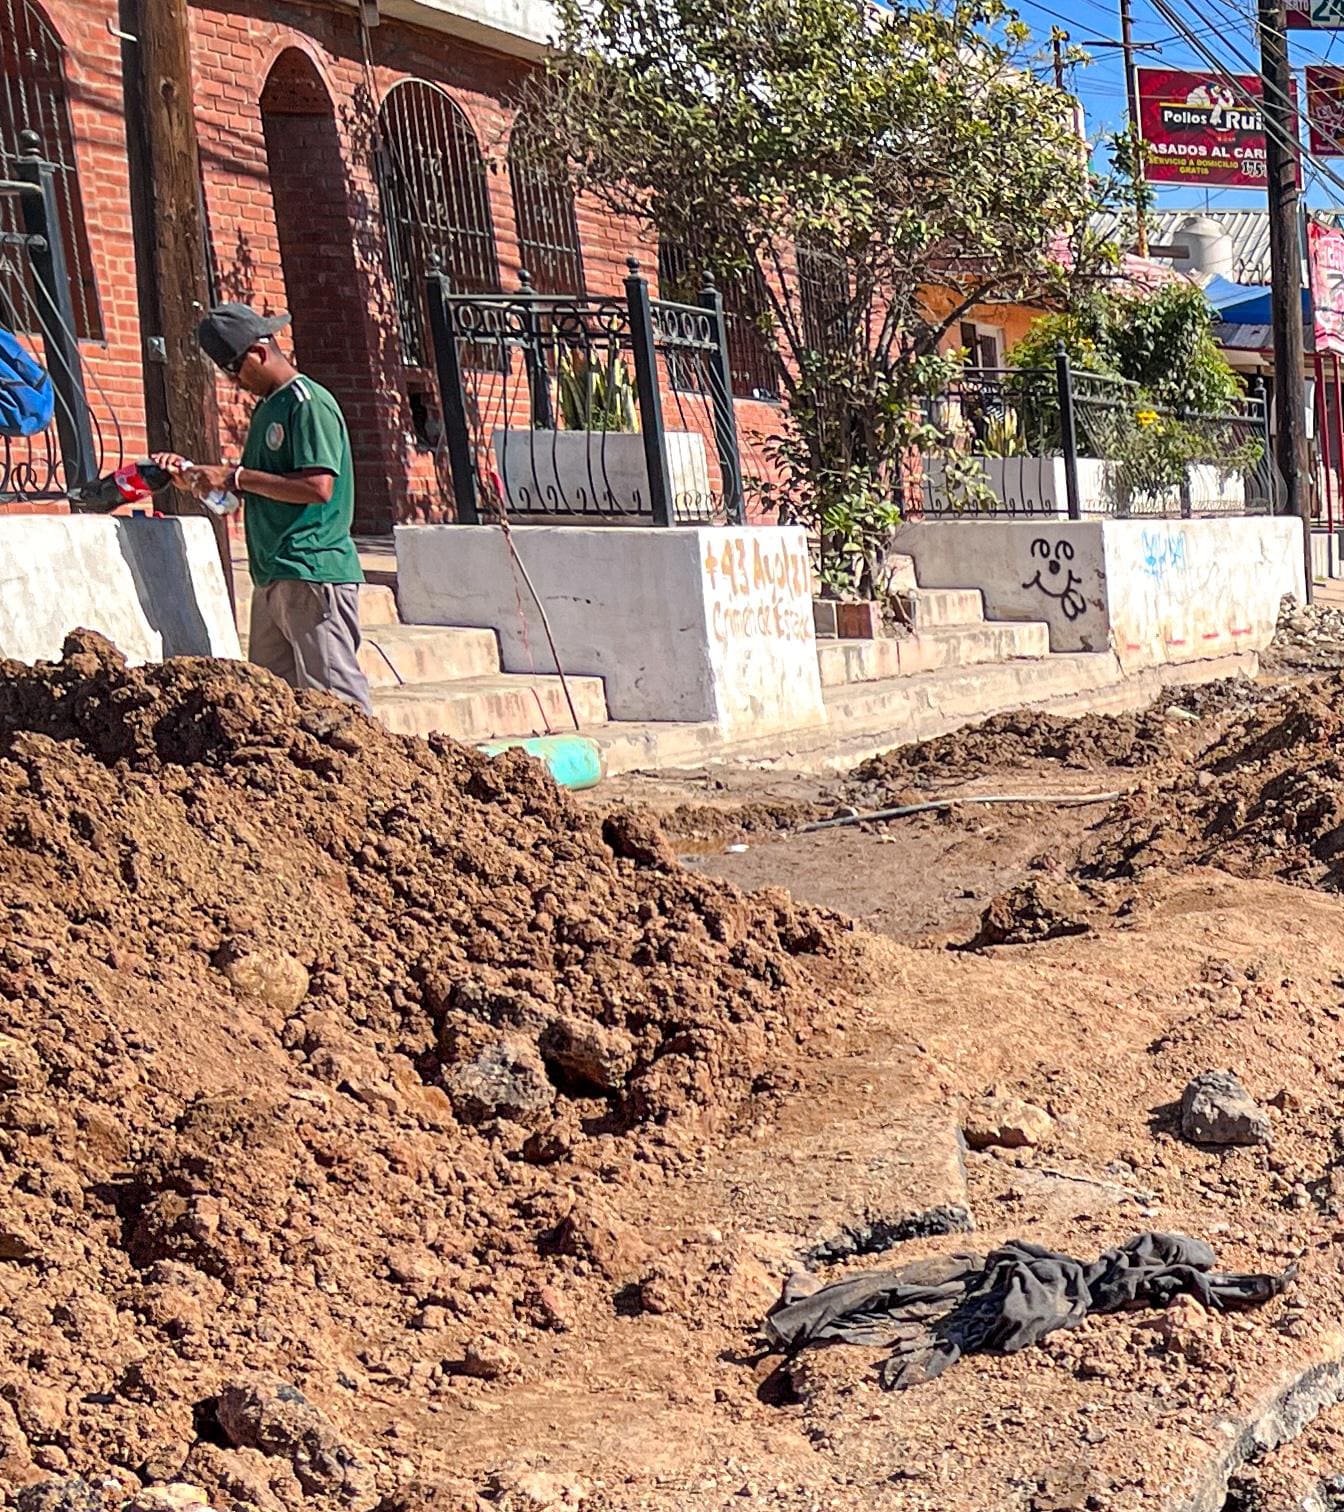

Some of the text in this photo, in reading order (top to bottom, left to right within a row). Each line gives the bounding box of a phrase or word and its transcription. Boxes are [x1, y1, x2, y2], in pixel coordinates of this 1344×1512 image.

[1163, 110, 1266, 130] Pollos Rui
[1148, 143, 1267, 160] ASADOS AL CAR
[1148, 156, 1187, 166] SERVICIO
[1196, 159, 1239, 169] DOMICILIO
[1179, 167, 1210, 175] GRATIS
